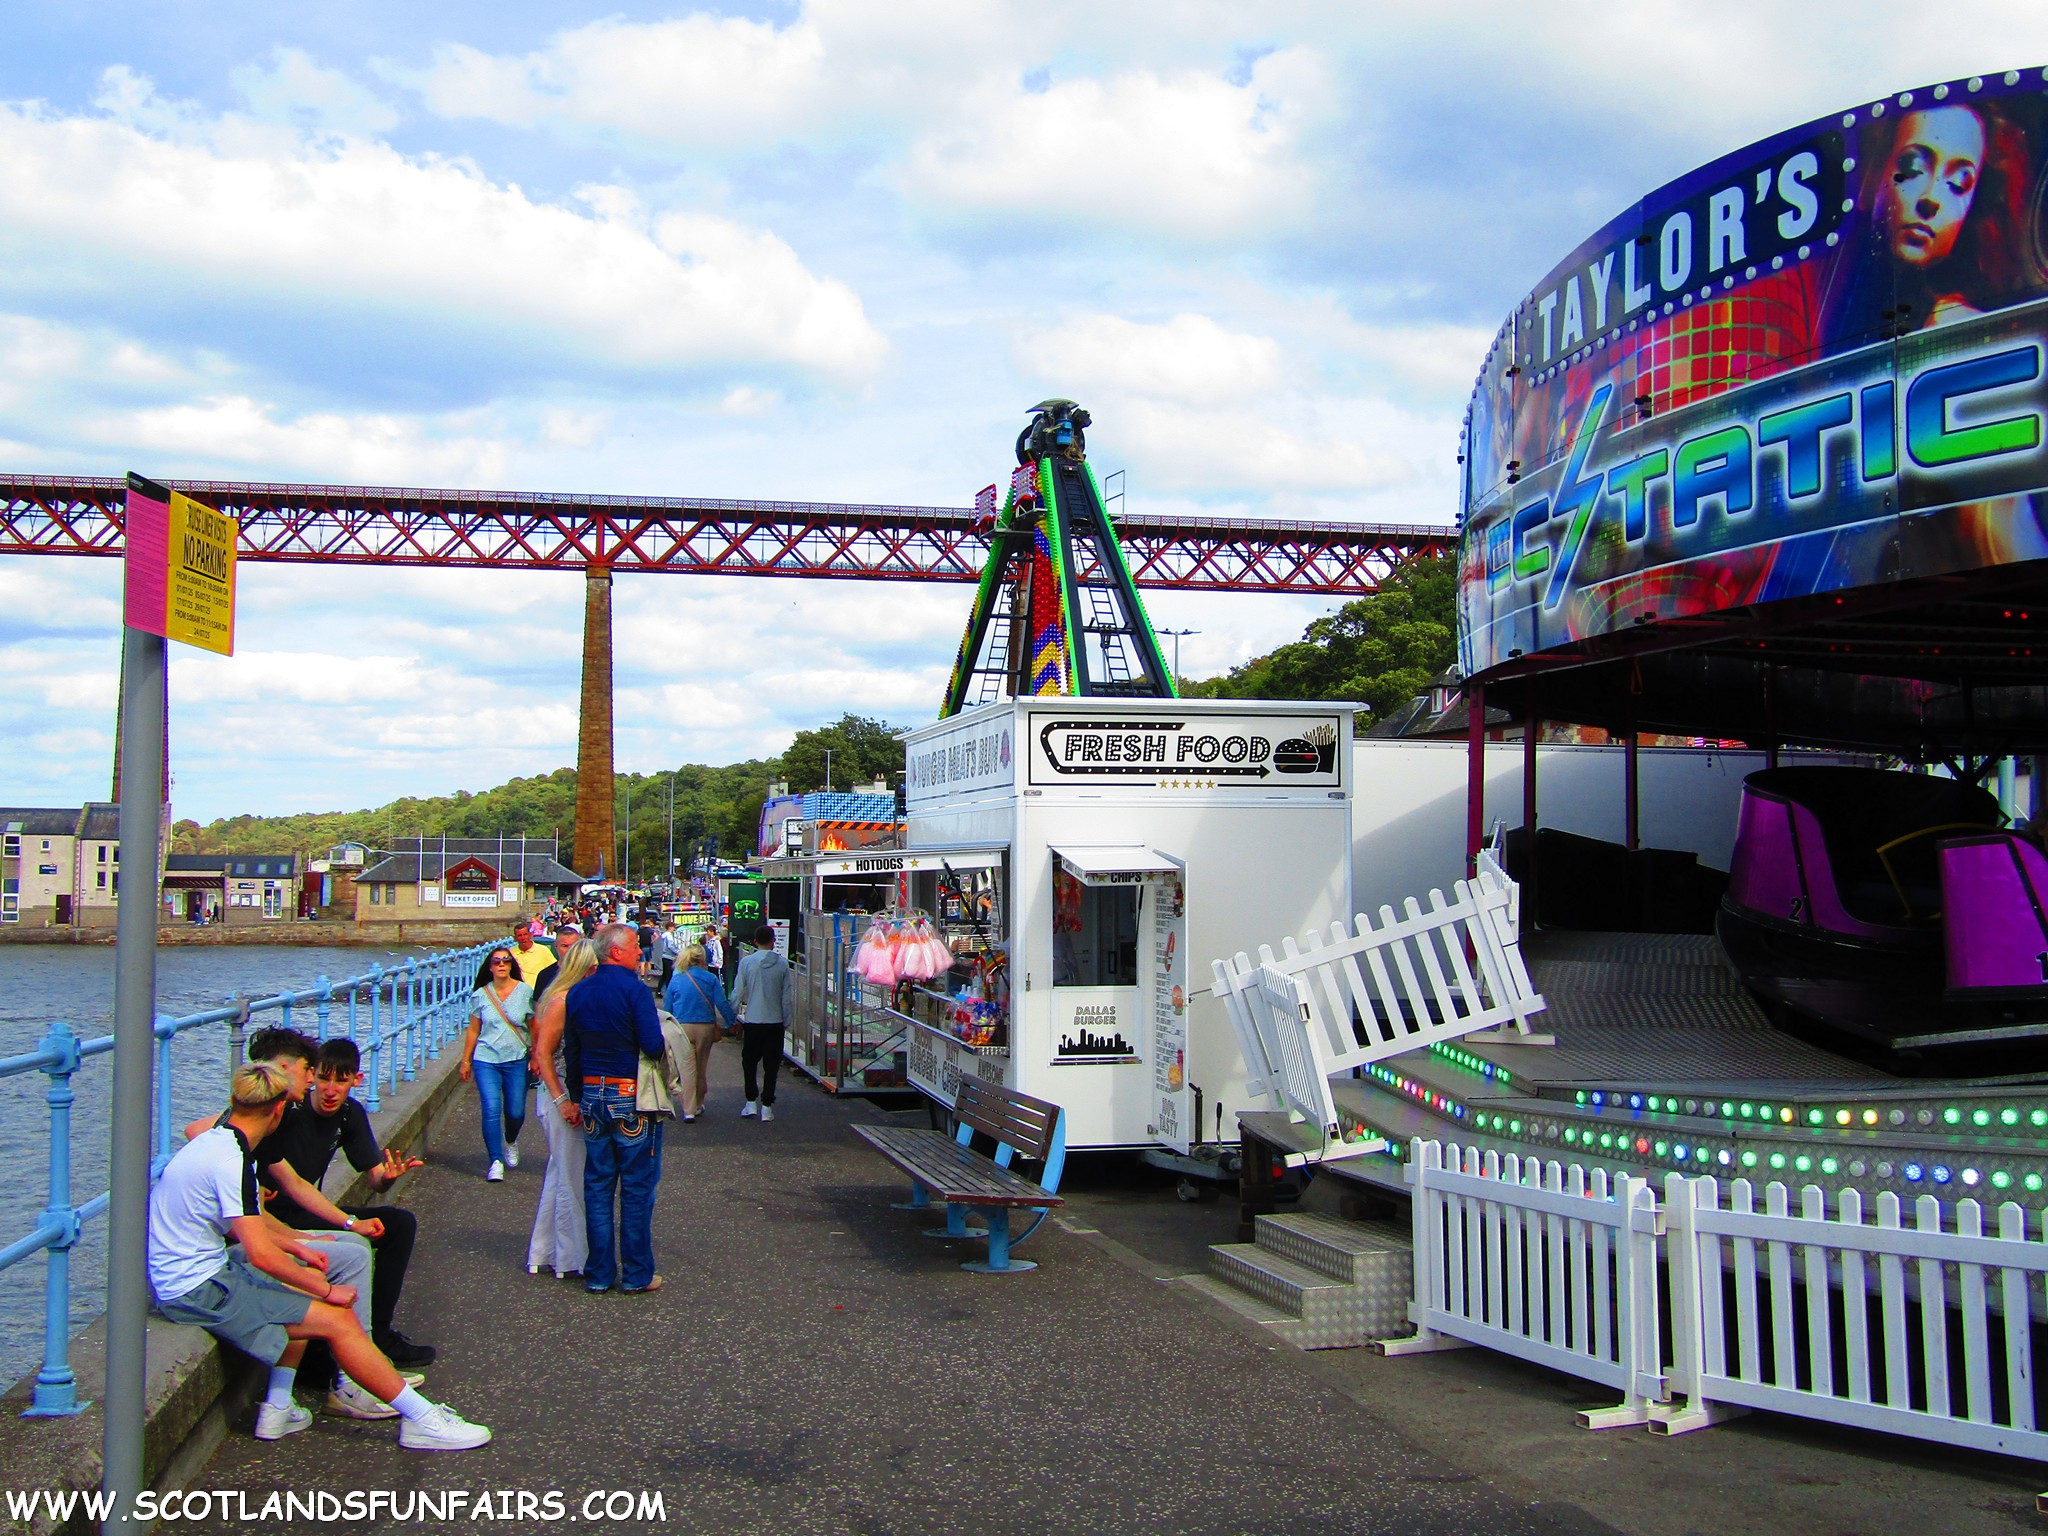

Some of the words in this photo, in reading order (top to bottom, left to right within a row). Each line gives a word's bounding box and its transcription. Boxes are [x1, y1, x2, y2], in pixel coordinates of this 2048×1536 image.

[1537, 150, 1820, 364] TAYLOR'S
[184, 533, 194, 566] NO
[196, 538, 226, 579] PARKING
[176, 570, 187, 580] FROM
[175, 608, 186, 619] FROM
[1065, 734, 1166, 762] FRESH
[1176, 735, 1270, 763] FOOD
[918, 749, 946, 788] BURGER
[947, 739, 976, 782] MEATS
[856, 857, 903, 871] HOTDOGS
[1110, 872, 1142, 883] CHIPS
[674, 914, 699, 925] MOVE
[1076, 1006, 1116, 1016] DALLAS
[1074, 1016, 1116, 1025] BURGER
[910, 1042, 937, 1085] BURGERS
[1159, 1113, 1179, 1138] TASTY
